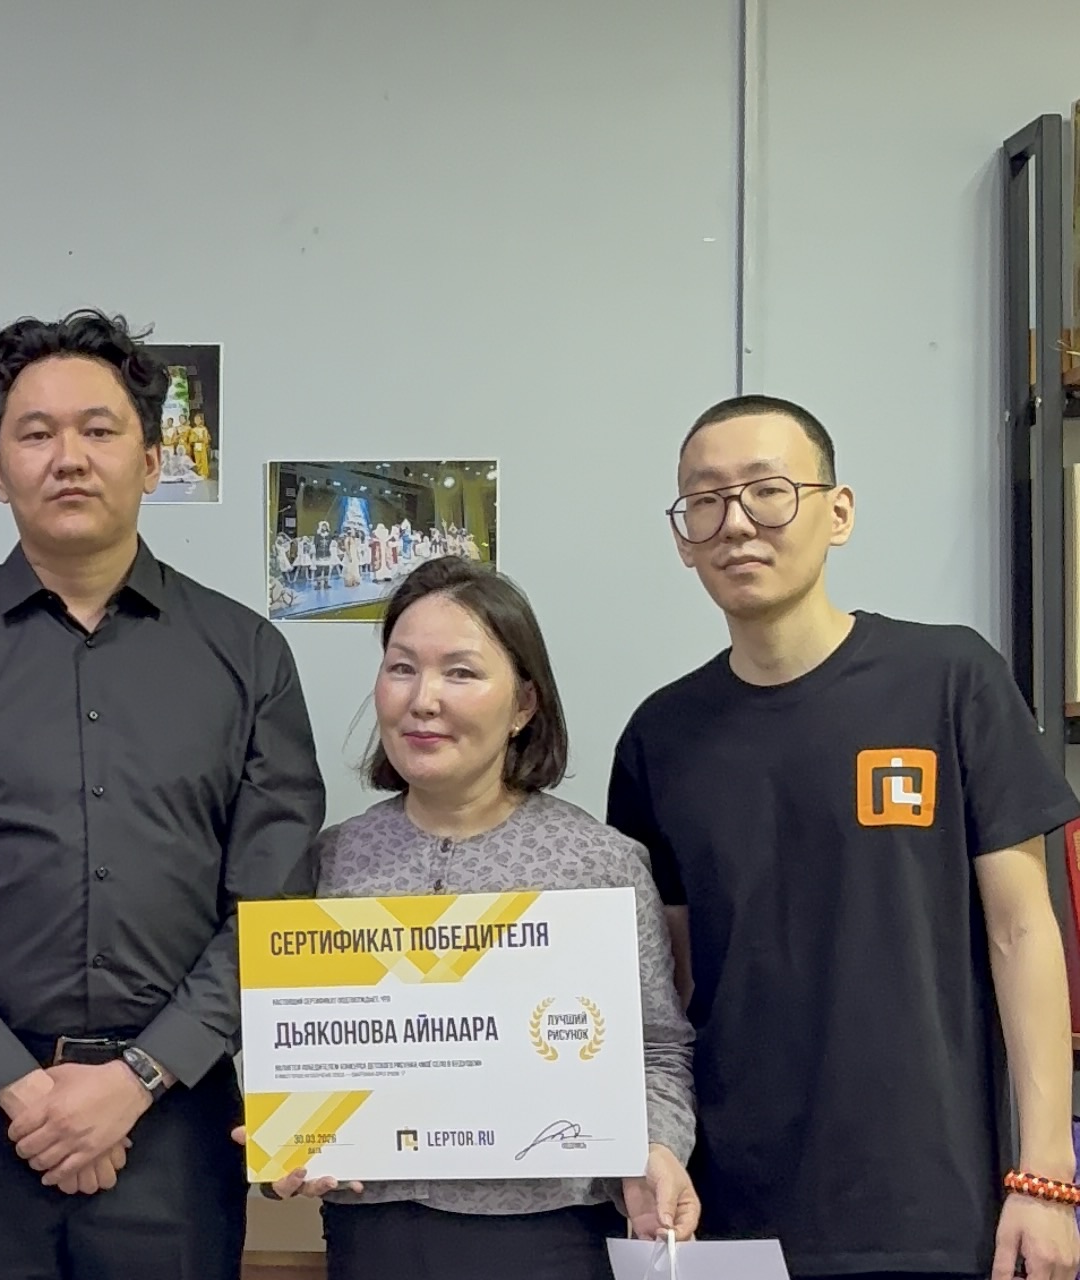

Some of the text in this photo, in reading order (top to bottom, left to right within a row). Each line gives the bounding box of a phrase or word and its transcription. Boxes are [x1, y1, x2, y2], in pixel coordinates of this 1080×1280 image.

[270, 922, 549, 956] СЕРТИФИКАТ ПОБЕДИТЕЛЯ
[547, 1011, 588, 1026] ЛУЧШИЙ
[274, 1014, 499, 1049] ДЬЯКОНОВА АЙНААРА
[547, 1028, 589, 1041] РИСУНОК
[426, 1130, 495, 1147] LEPTOR.RU
